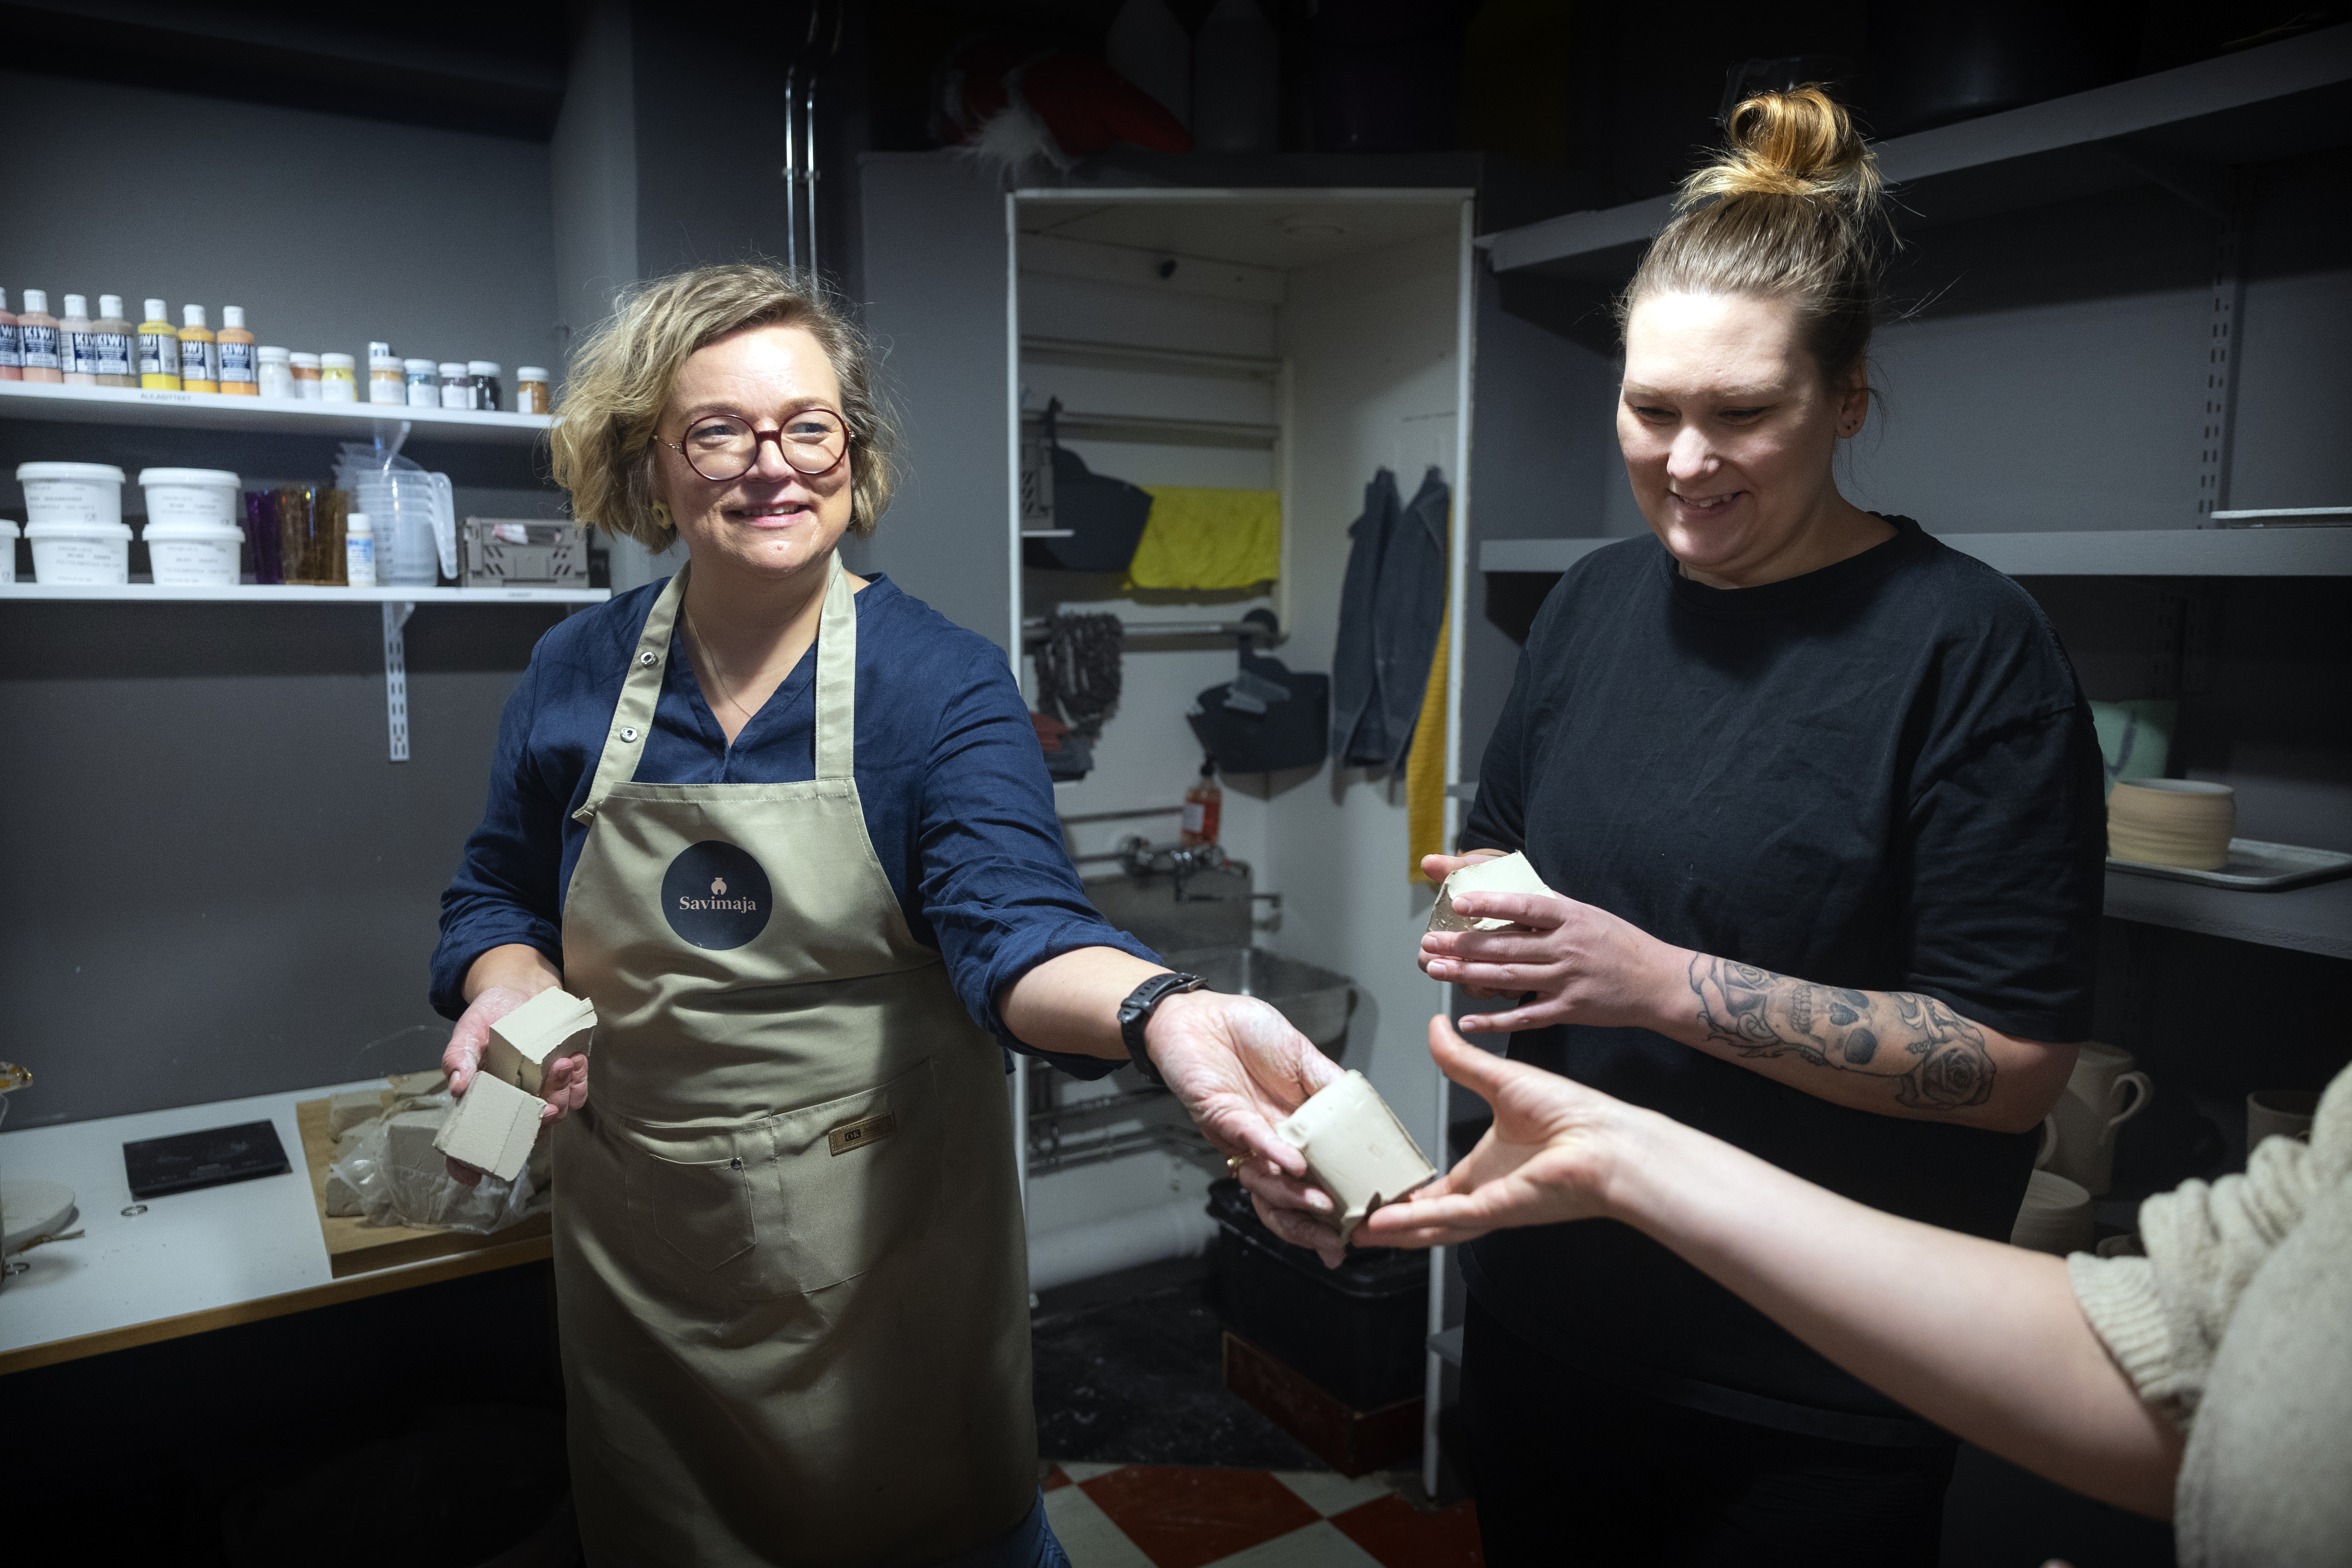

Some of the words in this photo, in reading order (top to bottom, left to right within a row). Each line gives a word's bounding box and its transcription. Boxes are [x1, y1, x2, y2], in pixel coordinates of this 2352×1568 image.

[25, 325, 54, 338] KIWI
[98, 333, 125, 346] KIWI
[183, 340, 201, 352] IWI
[222, 342, 248, 354] KIWI
[679, 896, 757, 913] Savimaja
[846, 1131, 860, 1140] OK
